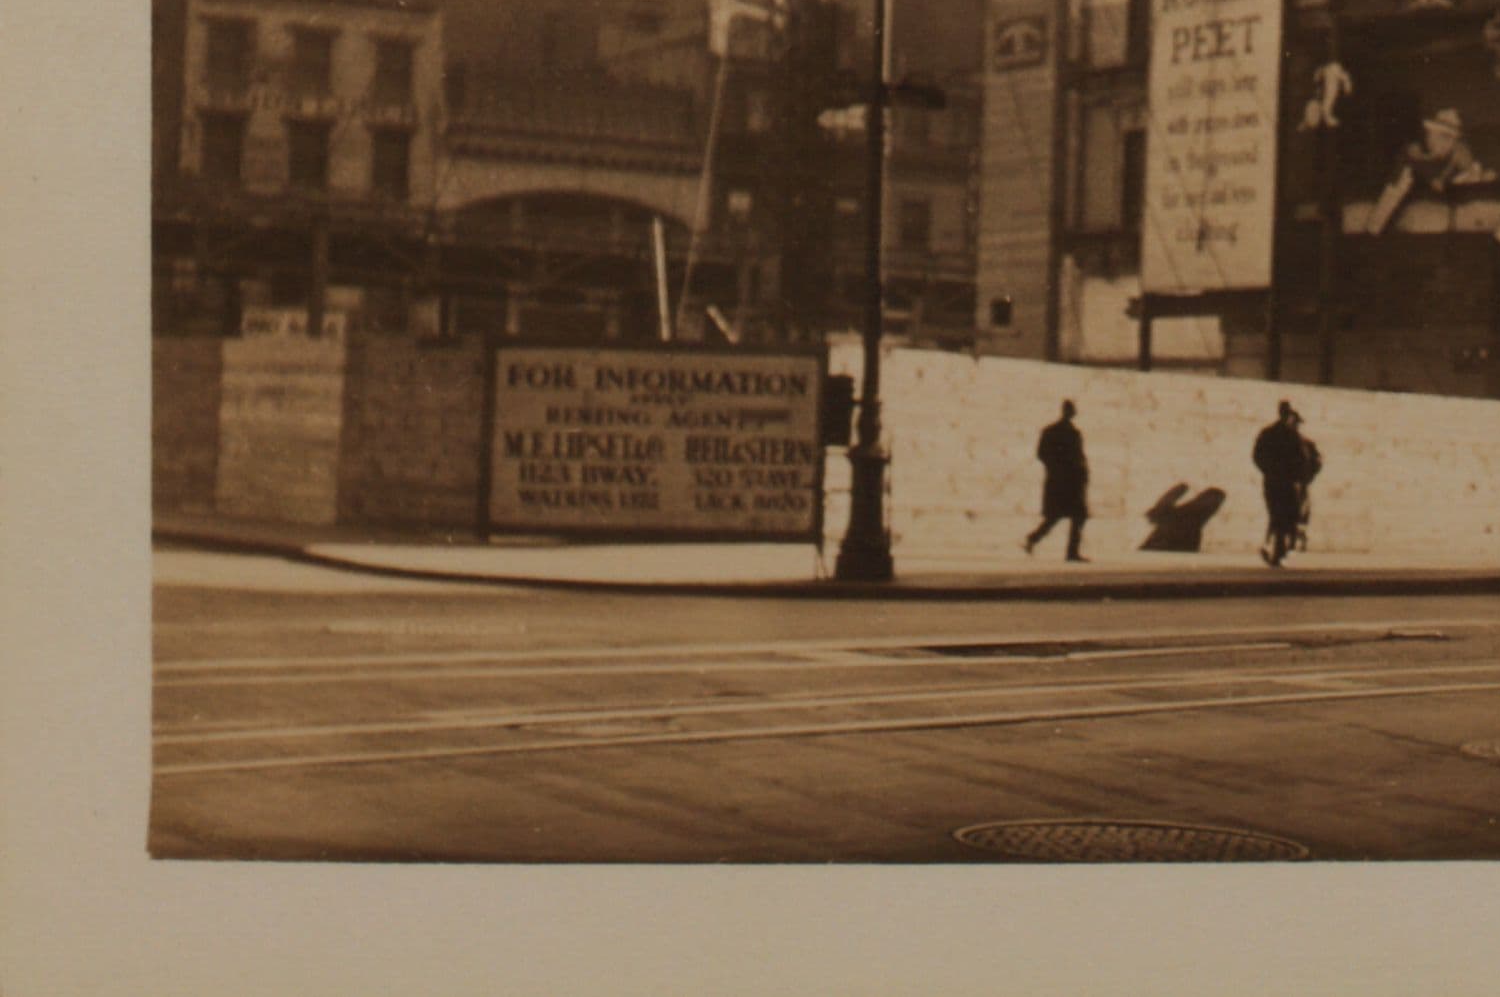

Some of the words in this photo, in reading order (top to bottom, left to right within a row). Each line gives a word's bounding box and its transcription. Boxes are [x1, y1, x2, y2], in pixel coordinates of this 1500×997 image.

[1169, 15, 1263, 66] PEET
[507, 363, 577, 390] FOR
[594, 366, 809, 398] INFORMATION
